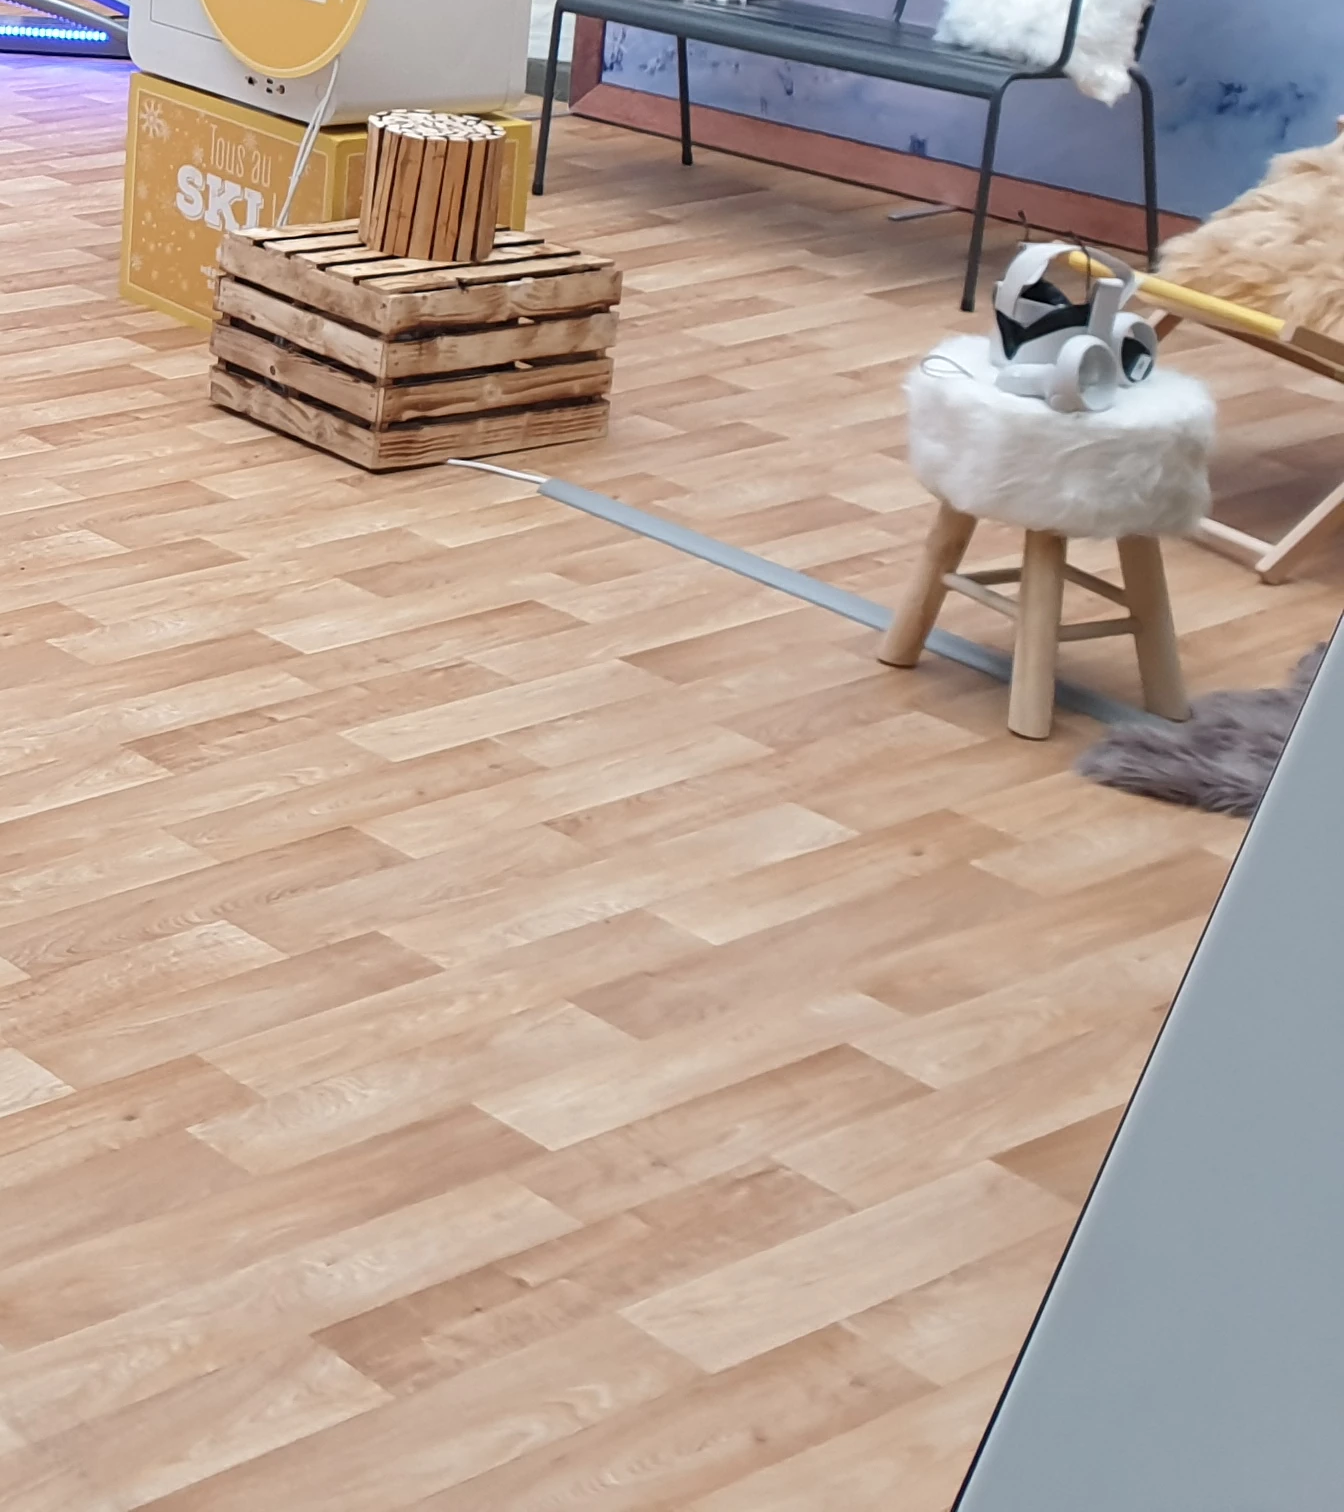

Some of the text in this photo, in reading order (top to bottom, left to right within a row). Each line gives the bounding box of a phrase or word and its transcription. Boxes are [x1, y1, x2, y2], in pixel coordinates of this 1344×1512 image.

[209, 123, 272, 188] Tous au
[175, 164, 265, 233] SKI
